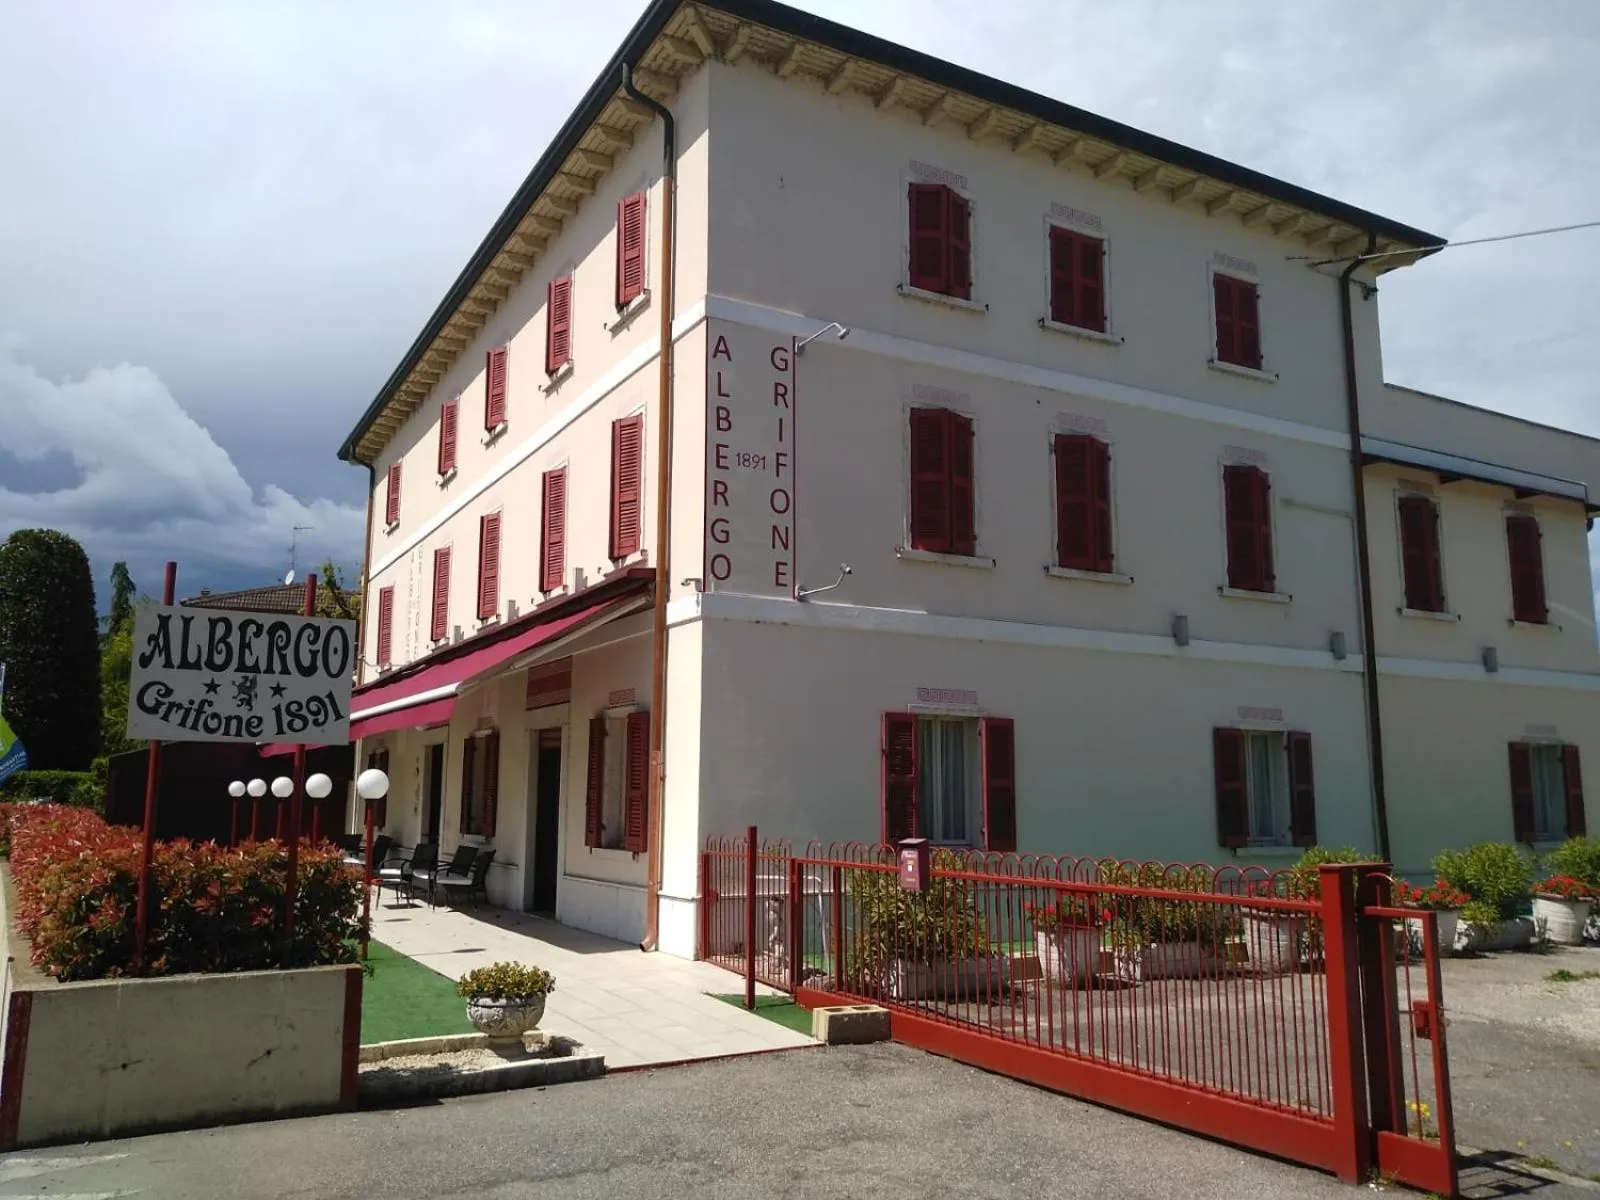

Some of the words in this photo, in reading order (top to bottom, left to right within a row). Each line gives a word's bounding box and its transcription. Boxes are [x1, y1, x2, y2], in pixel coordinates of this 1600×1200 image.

[710, 335, 732, 581] ALBERGO
[735, 451, 767, 471] 1891
[769, 346, 791, 588] GRIFONE
[138, 613, 350, 679] ALBERGO
[136, 681, 264, 738] Grifone
[272, 688, 346, 736] 1891
